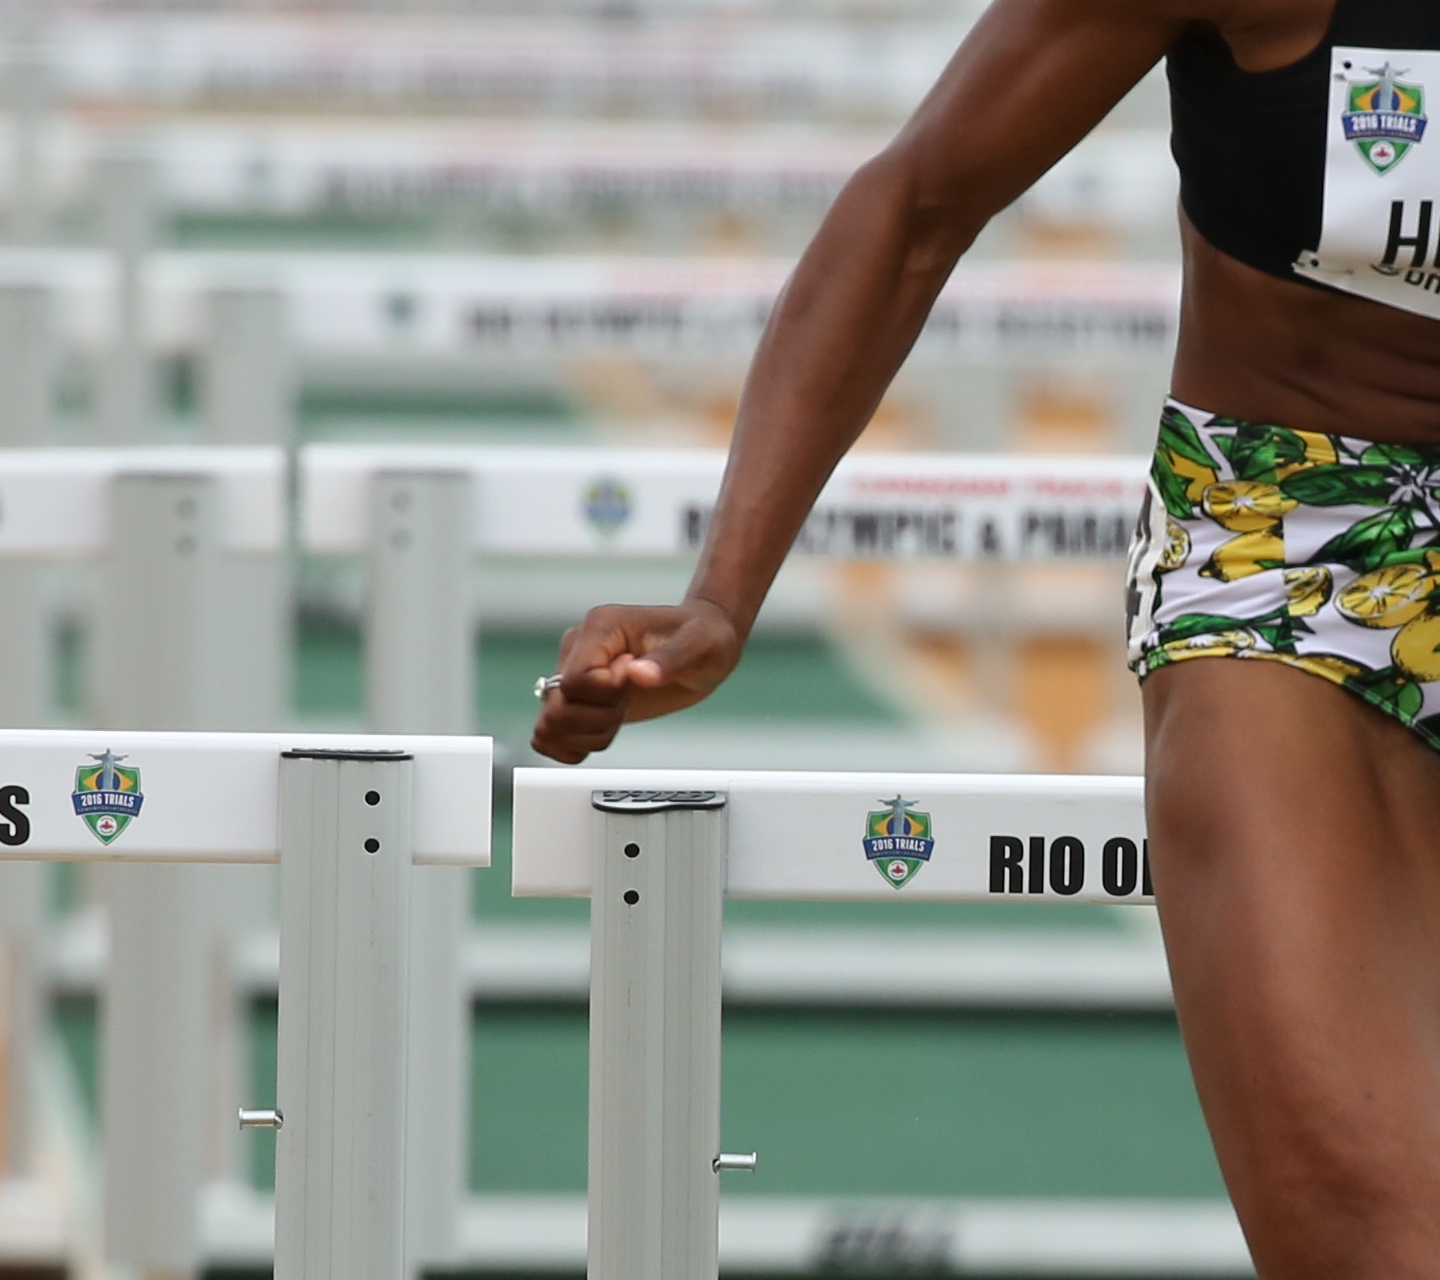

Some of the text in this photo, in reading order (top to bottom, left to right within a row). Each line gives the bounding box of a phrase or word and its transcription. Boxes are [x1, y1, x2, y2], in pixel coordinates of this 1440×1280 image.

[103, 793, 135, 808] TRIALS
[895, 838, 926, 852] TRIALS
[989, 835, 1085, 895] RIO
